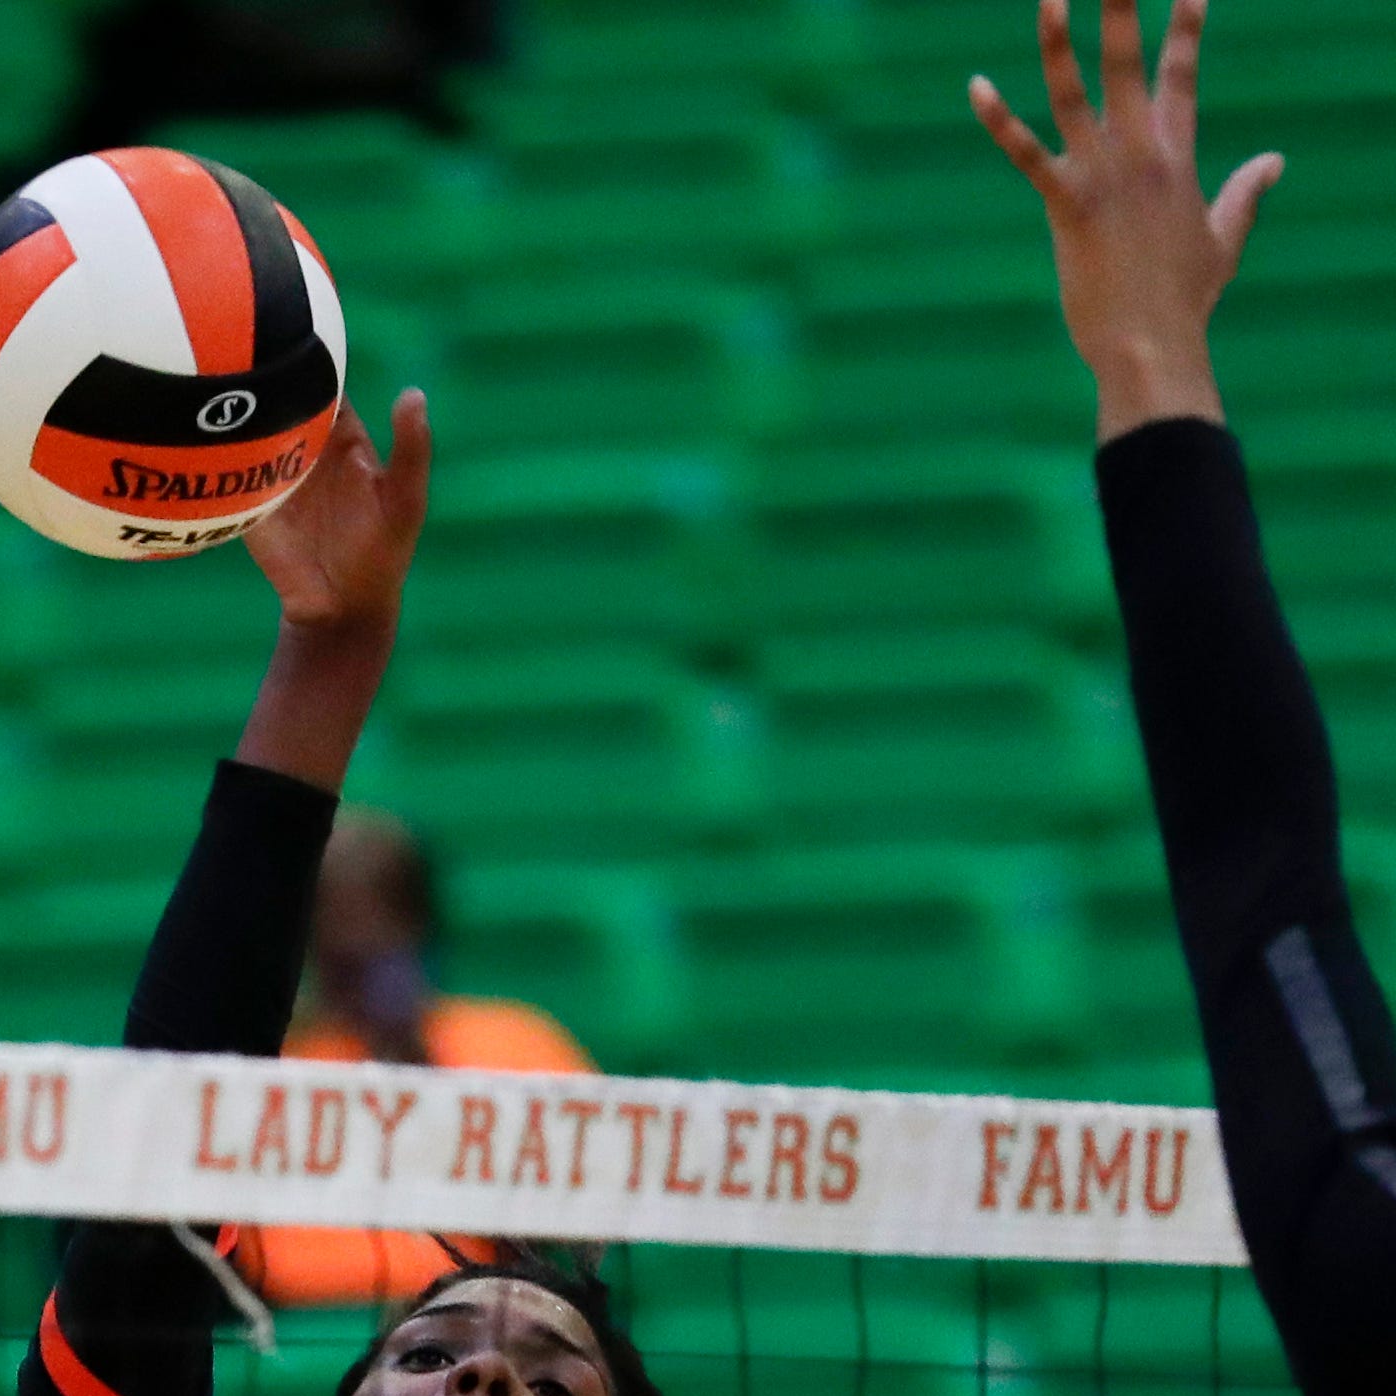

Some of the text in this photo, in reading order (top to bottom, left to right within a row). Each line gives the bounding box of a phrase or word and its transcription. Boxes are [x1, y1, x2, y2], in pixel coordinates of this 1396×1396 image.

[104, 442, 305, 501] SPALDING
[194, 1080, 418, 1179] LADY
[449, 1095, 861, 1205] RATTLERS
[977, 1120, 1190, 1218] FAMU
